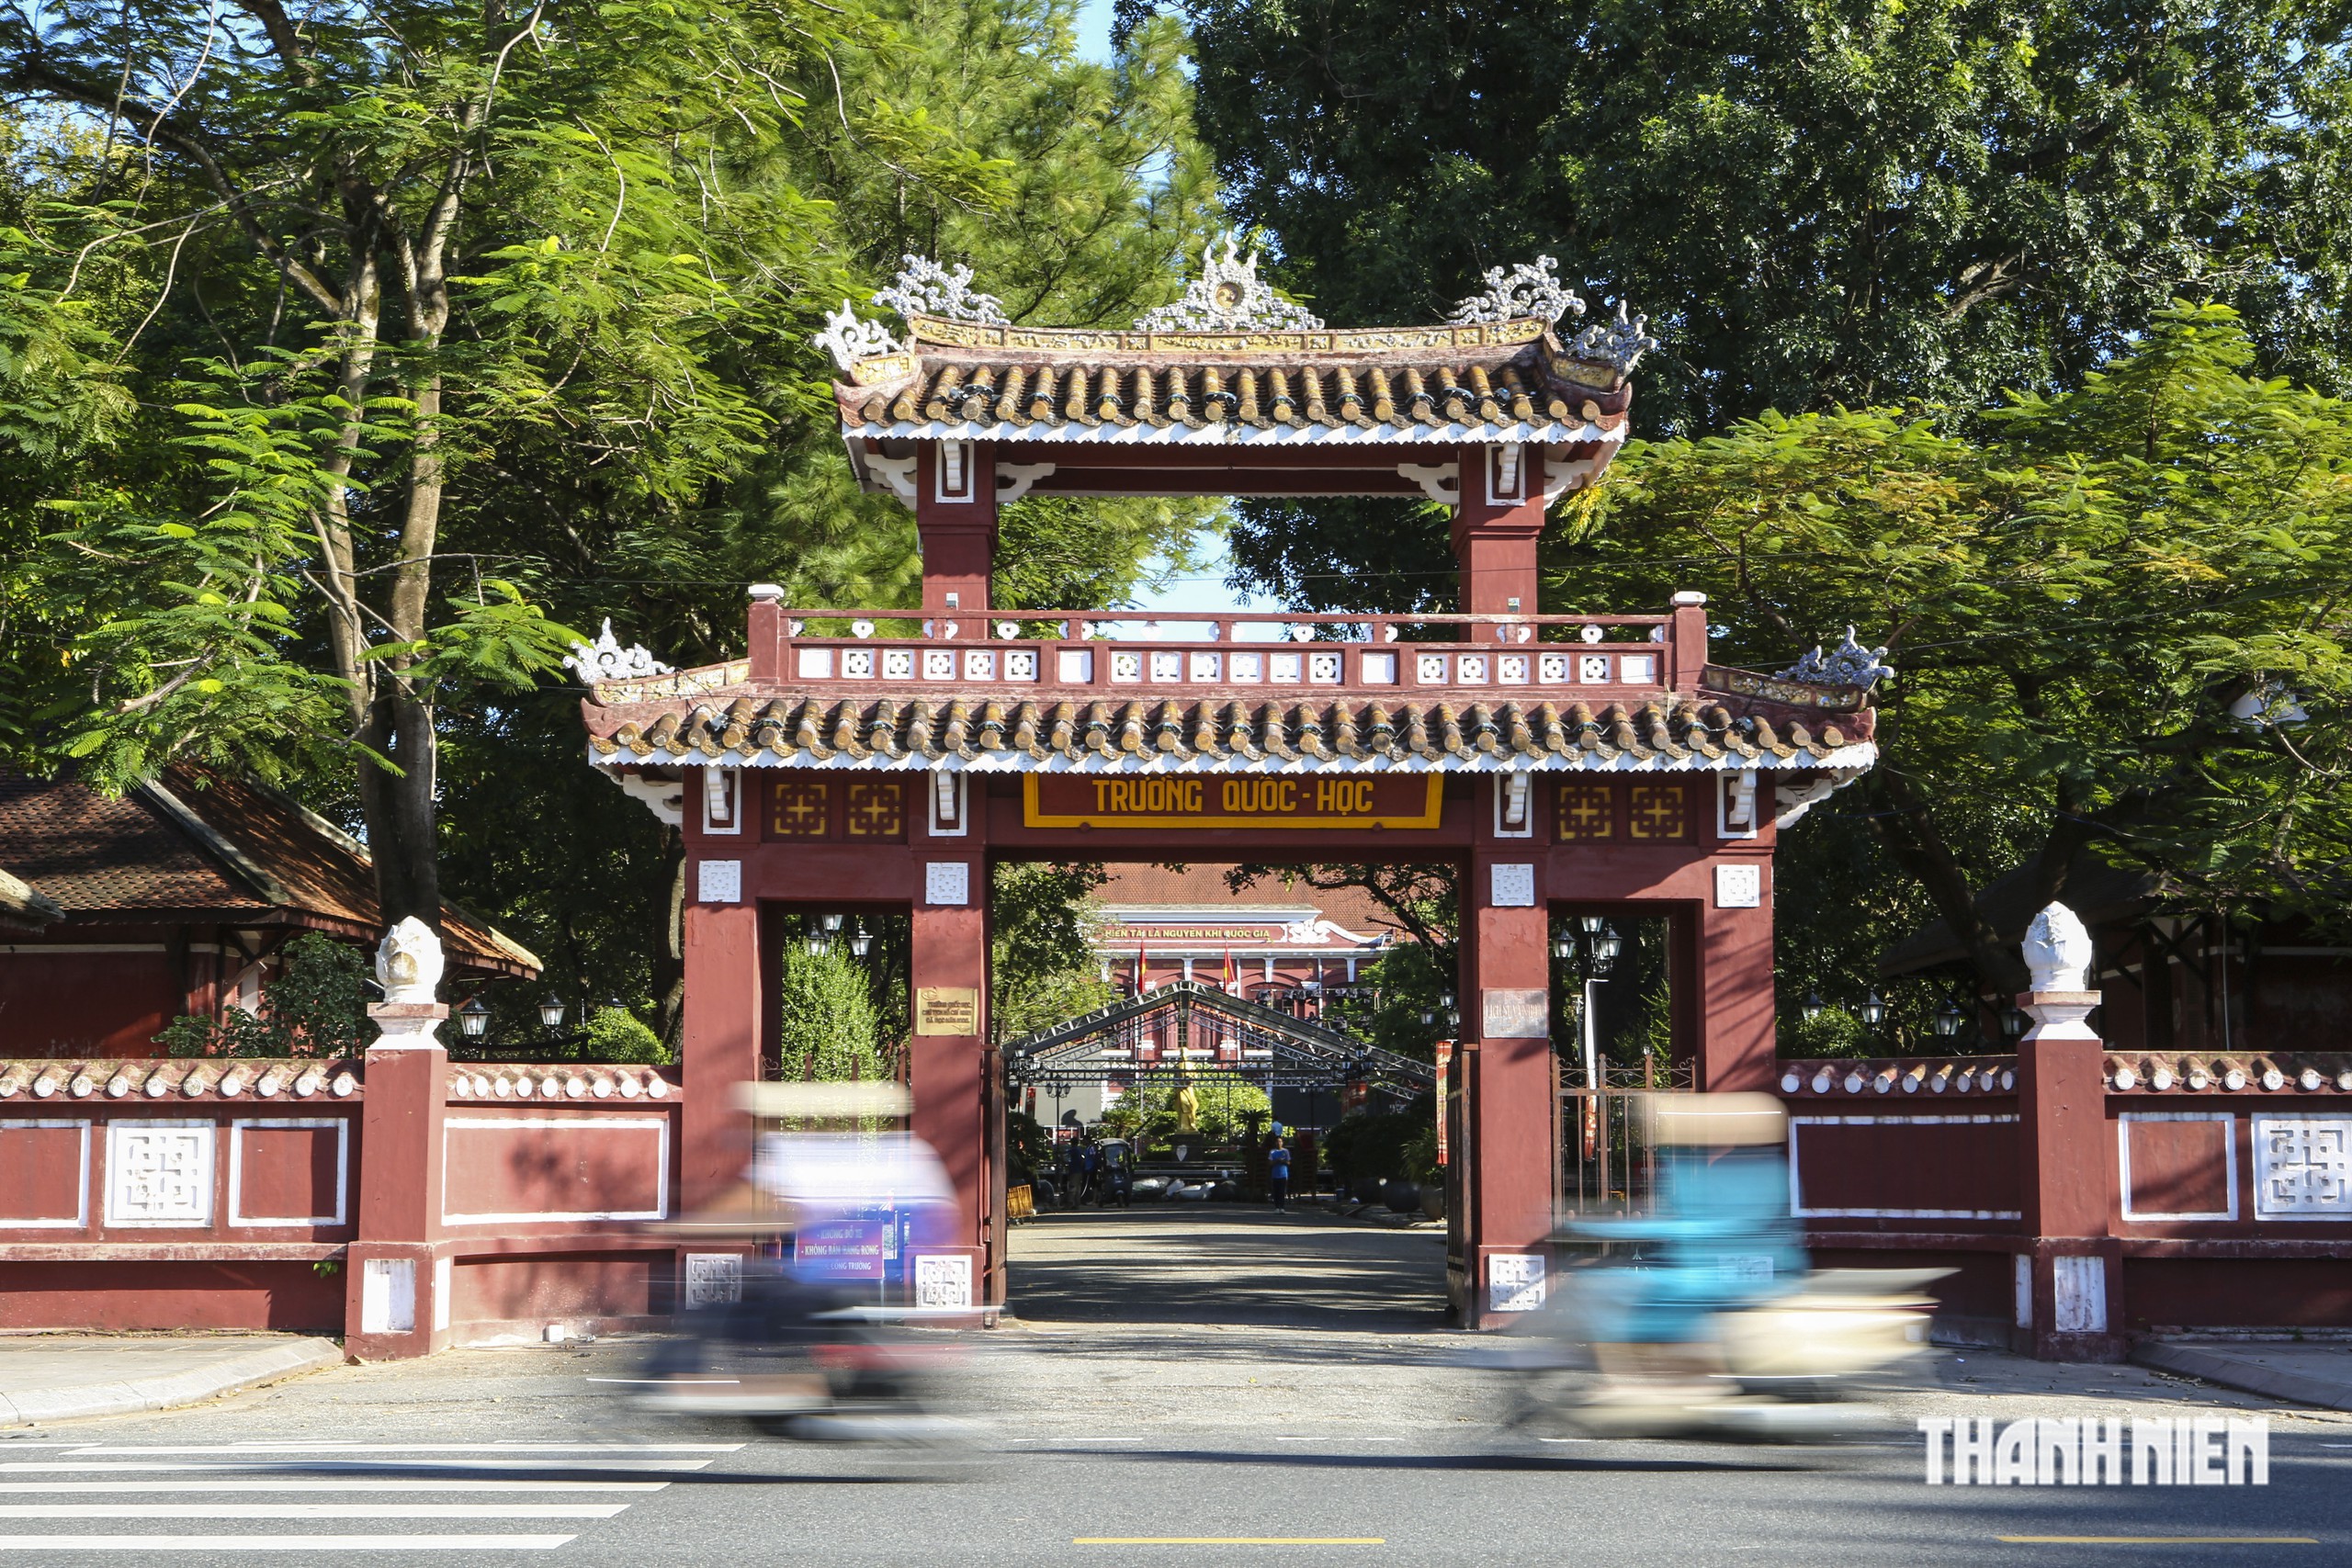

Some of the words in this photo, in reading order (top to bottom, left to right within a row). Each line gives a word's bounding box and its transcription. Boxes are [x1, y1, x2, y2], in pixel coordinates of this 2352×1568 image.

[1091, 774, 1203, 812] TRƯỜNG
[1317, 780, 1374, 816] HỌC
[1148, 927, 1160, 938] LÀ
[1162, 927, 1202, 938] NGUYÊN
[1204, 928, 1222, 938] KHÍ
[1252, 930, 1271, 938] GIA
[805, 1243, 827, 1256] KHÔNG
